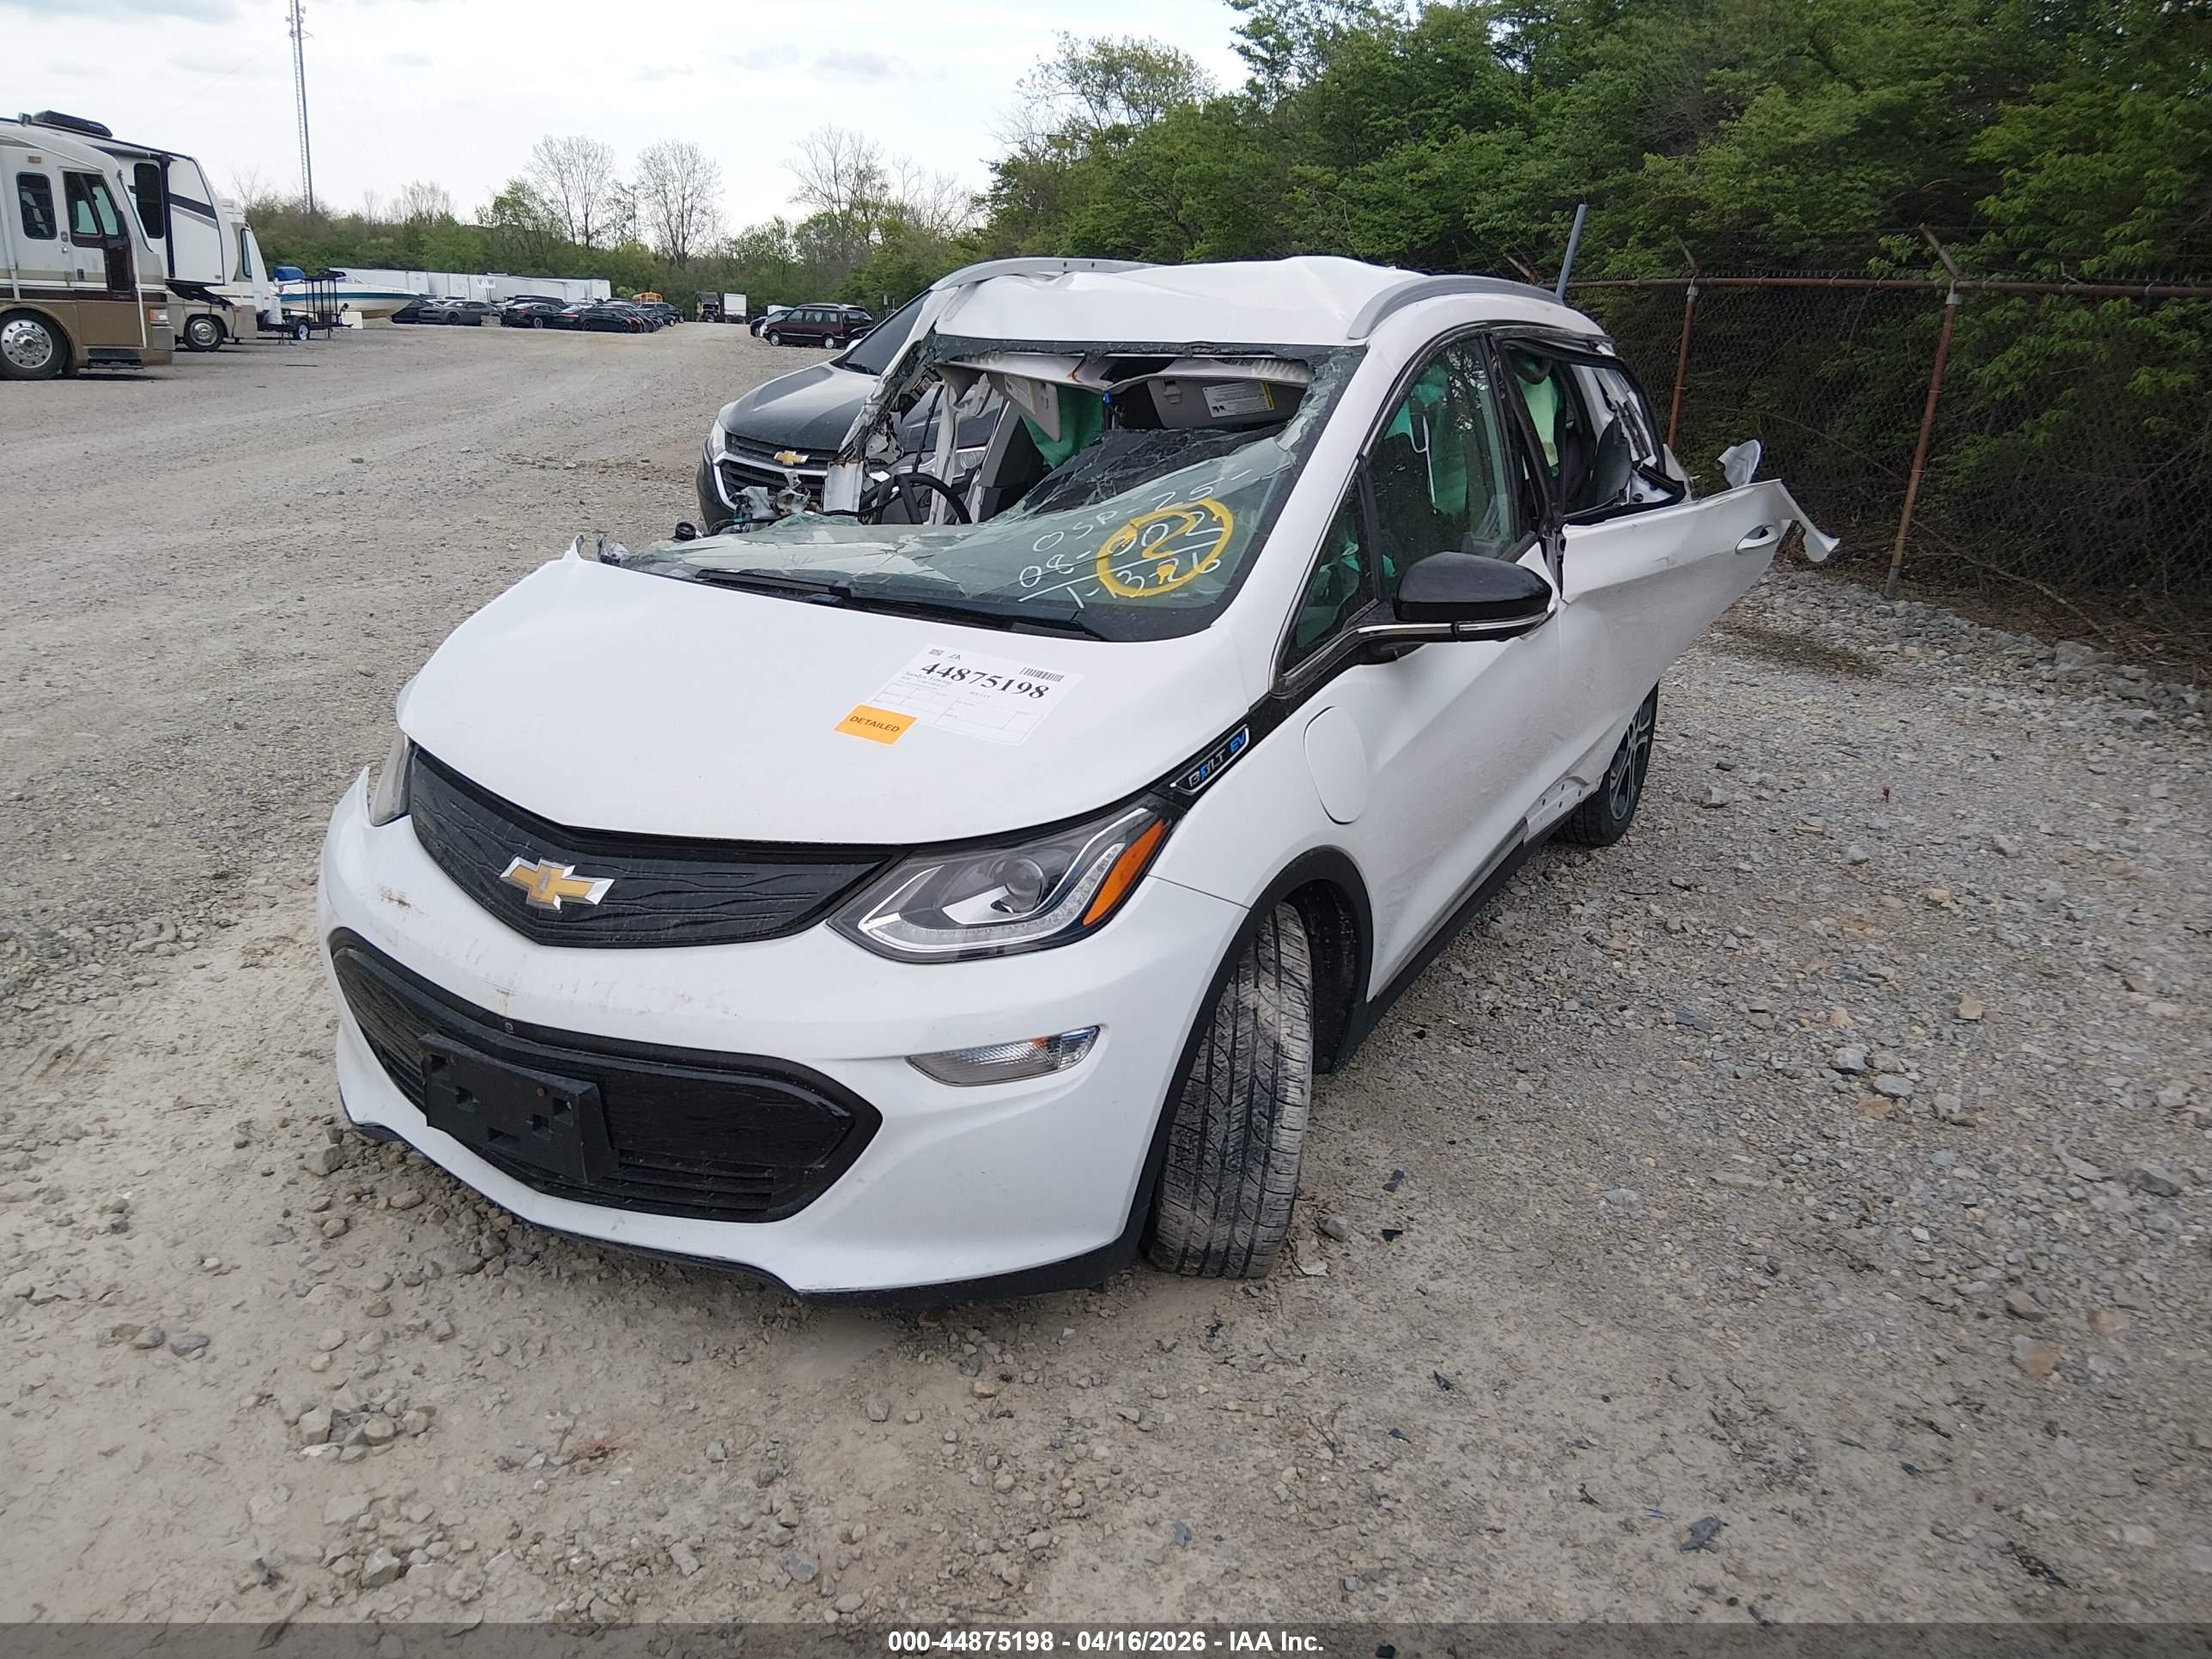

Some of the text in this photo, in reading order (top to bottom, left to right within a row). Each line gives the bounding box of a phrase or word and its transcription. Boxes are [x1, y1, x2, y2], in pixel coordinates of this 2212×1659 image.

[921, 663, 1050, 699] 44875198
[849, 715, 900, 733] DETAILED
[1188, 731, 1245, 787] BOLT EV
